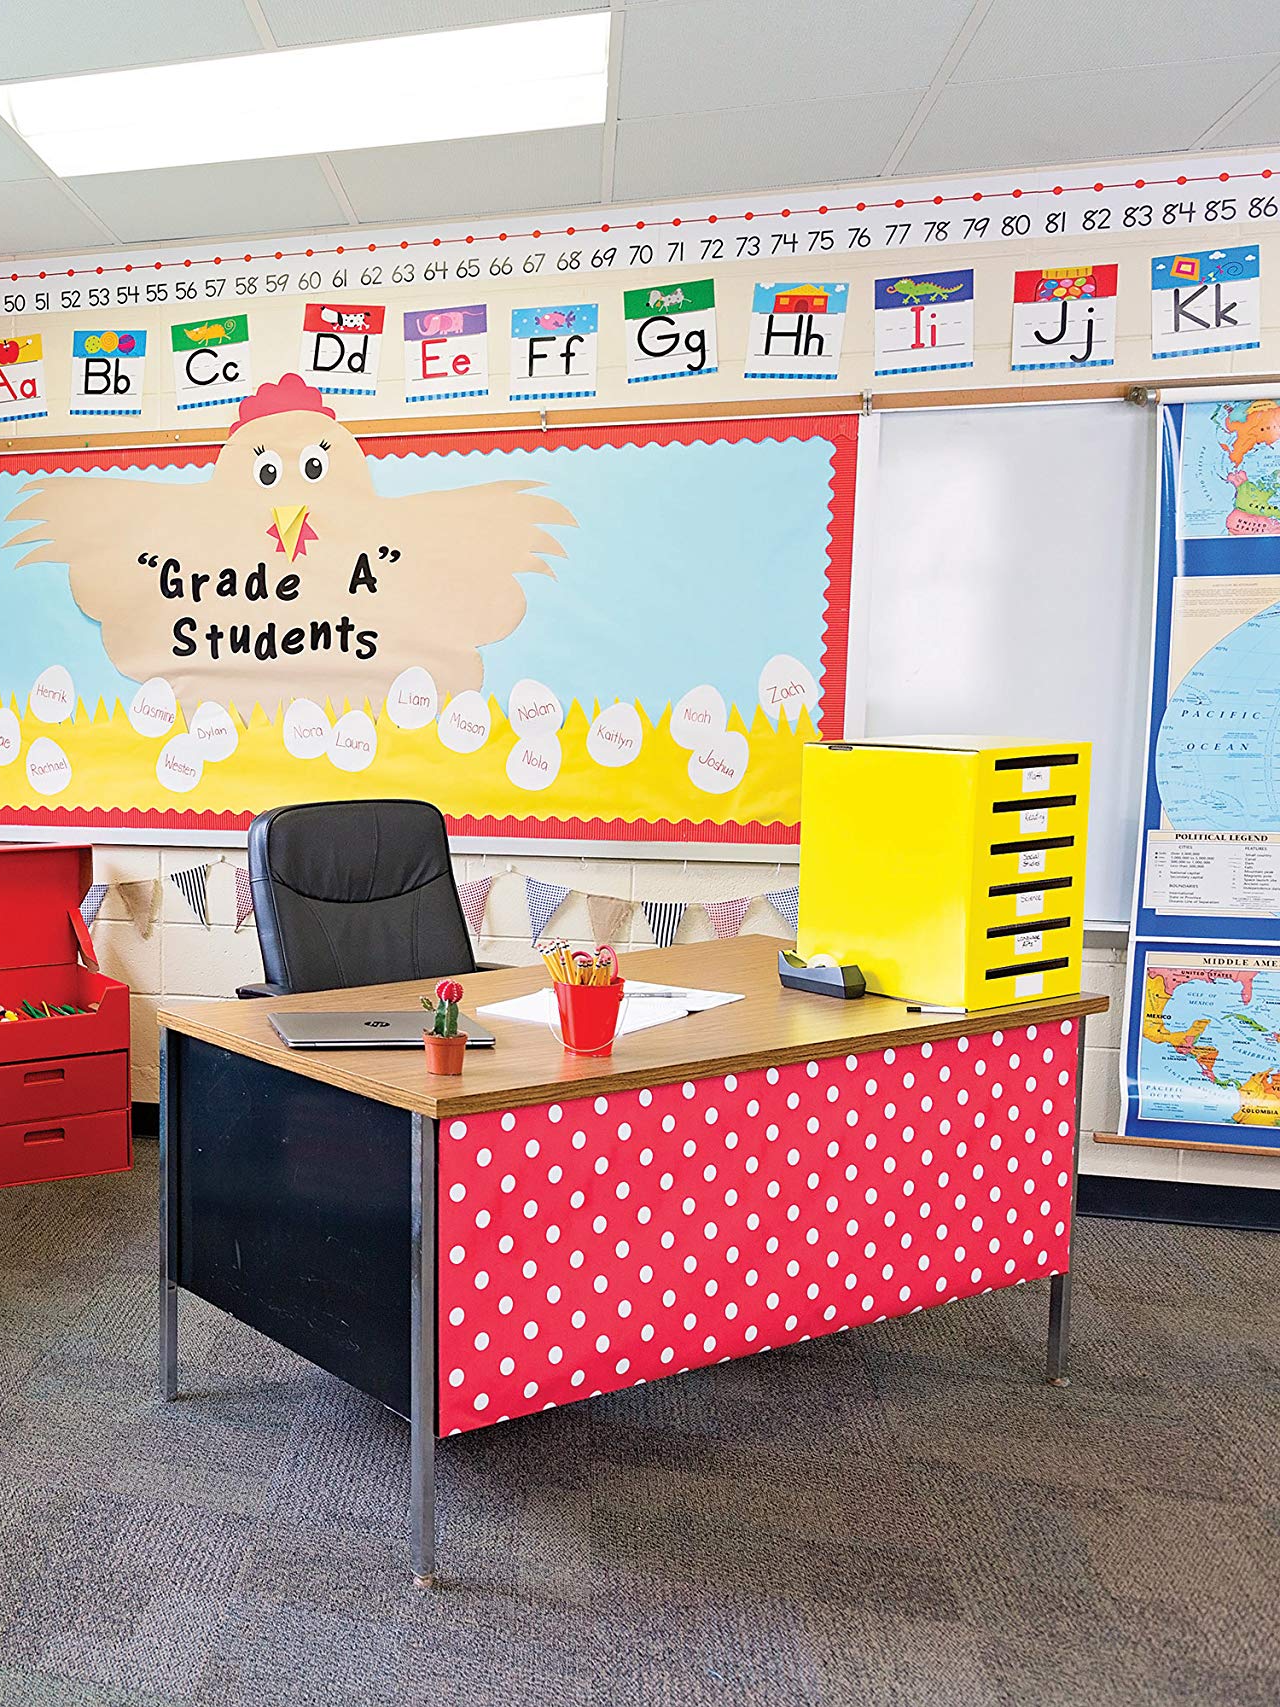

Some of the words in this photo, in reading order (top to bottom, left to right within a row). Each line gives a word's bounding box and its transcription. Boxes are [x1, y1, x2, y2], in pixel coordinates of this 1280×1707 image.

[35, 292, 50, 311] 51
[61, 289, 81, 309] 52
[116, 285, 140, 305] 54
[205, 278, 227, 298] 57
[235, 276, 259, 296] 58
[298, 271, 322, 291] 60
[360, 266, 383, 286] 62
[423, 261, 449, 281] 64
[522, 253, 546, 274] 67
[590, 247, 618, 269] 69
[629, 244, 654, 266] 70
[700, 238, 724, 260] 72
[770, 232, 799, 255] 74
[885, 223, 912, 246] 77
[923, 220, 951, 243] 78
[1001, 214, 1031, 237] 80
[1082, 208, 1112, 231] 82
[1204, 198, 1237, 222] 85
[1248, 195, 1279, 219] 86
[1174, 284, 1239, 333] Kk
[764, 314, 824, 356] Hh
[910, 306, 937, 350] Ii
[1034, 301, 1094, 363] Jj
[313, 333, 368, 374] Dd
[528, 335, 584, 377] Ff
[637, 316, 706, 371] Gg
[185, 348, 240, 386] Cc
[421, 338, 471, 379] Ee
[84, 357, 131, 395] Bb
[1236, 525, 1265, 533] STATES
[1238, 518, 1267, 528] UNITED
[171, 615, 379, 661] Students
[35, 682, 68, 704] Henrik
[397, 689, 431, 709] Liam
[766, 680, 805, 704] Zach
[133, 697, 176, 724] Jasmine
[517, 701, 556, 722] Nolan
[683, 708, 712, 726] Noah
[1181, 709, 1262, 720] PACIFIC
[196, 723, 228, 740] Dylan
[292, 723, 324, 739] Nora
[449, 710, 487, 737] Mason
[335, 730, 371, 753] Laura
[596, 723, 634, 751] Kaitlyn
[1186, 743, 1250, 751] OCEAN
[30, 756, 68, 774] Rachael
[163, 752, 198, 778] Westen
[520, 748, 550, 773] Nola
[698, 749, 735, 779] Joshua
[1175, 833, 1227, 841] POLITICAL
[1229, 834, 1269, 842] LEGEND
[1203, 958, 1249, 966] MIDDLE
[1253, 960, 1280, 968] AME
[1146, 1085, 1183, 1093] PACIFIC
